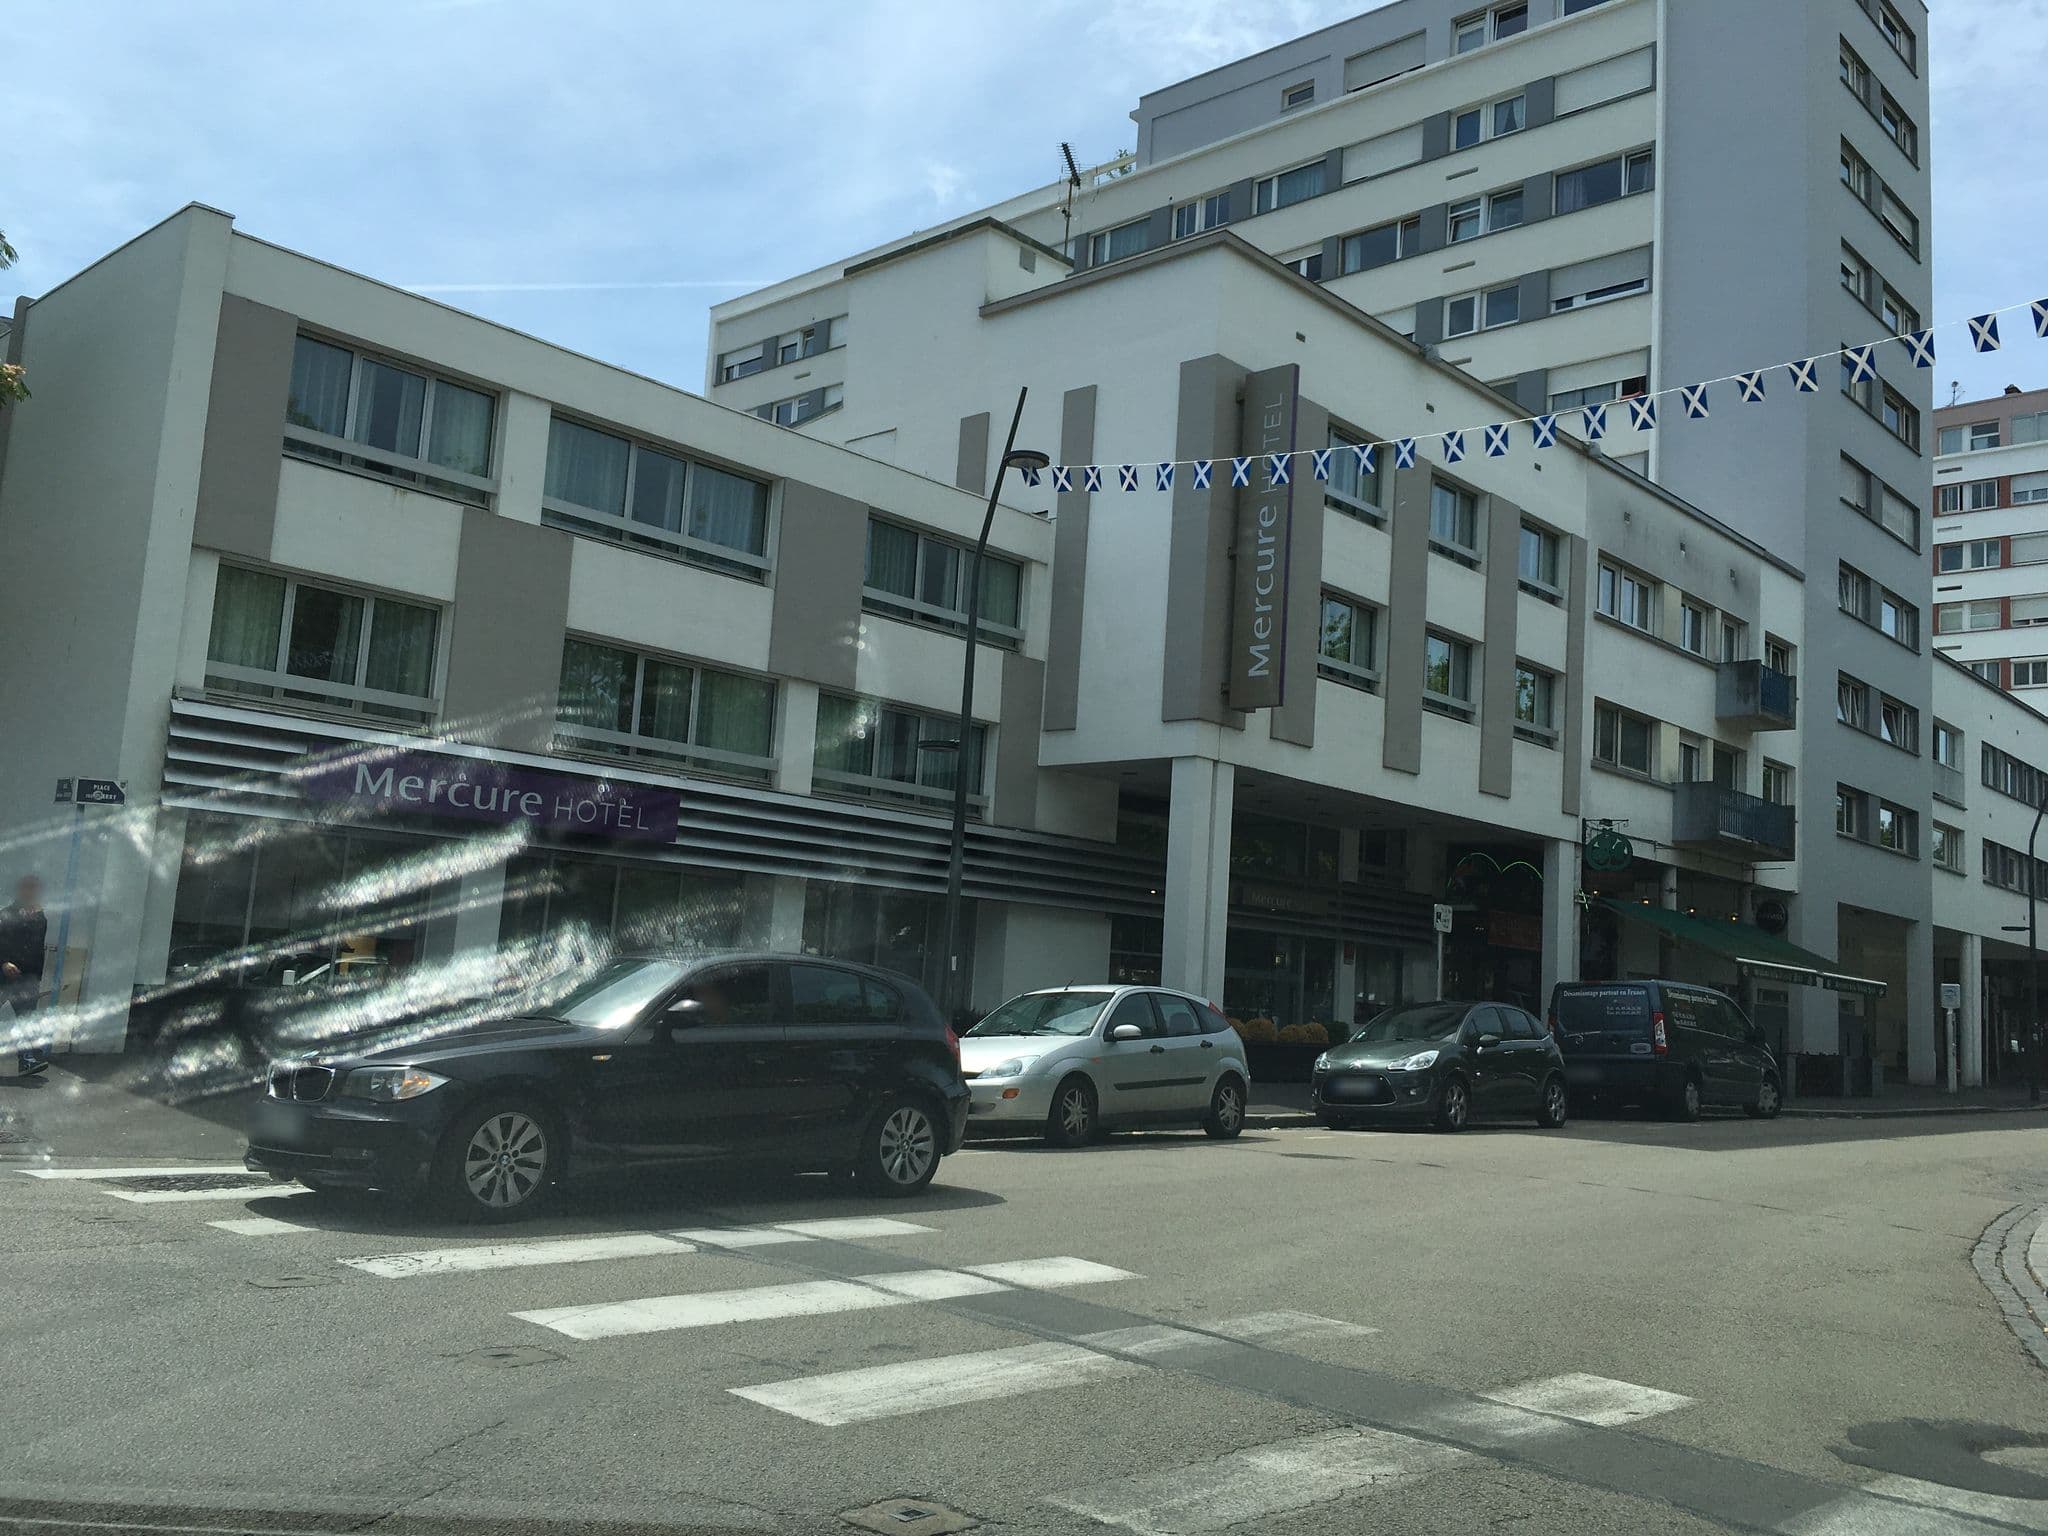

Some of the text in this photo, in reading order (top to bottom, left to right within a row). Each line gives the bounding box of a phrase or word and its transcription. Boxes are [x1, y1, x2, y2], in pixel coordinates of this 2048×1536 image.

[1247, 392, 1283, 677] Mercure HOTEL
[354, 763, 649, 831] Mercure HOTEL
